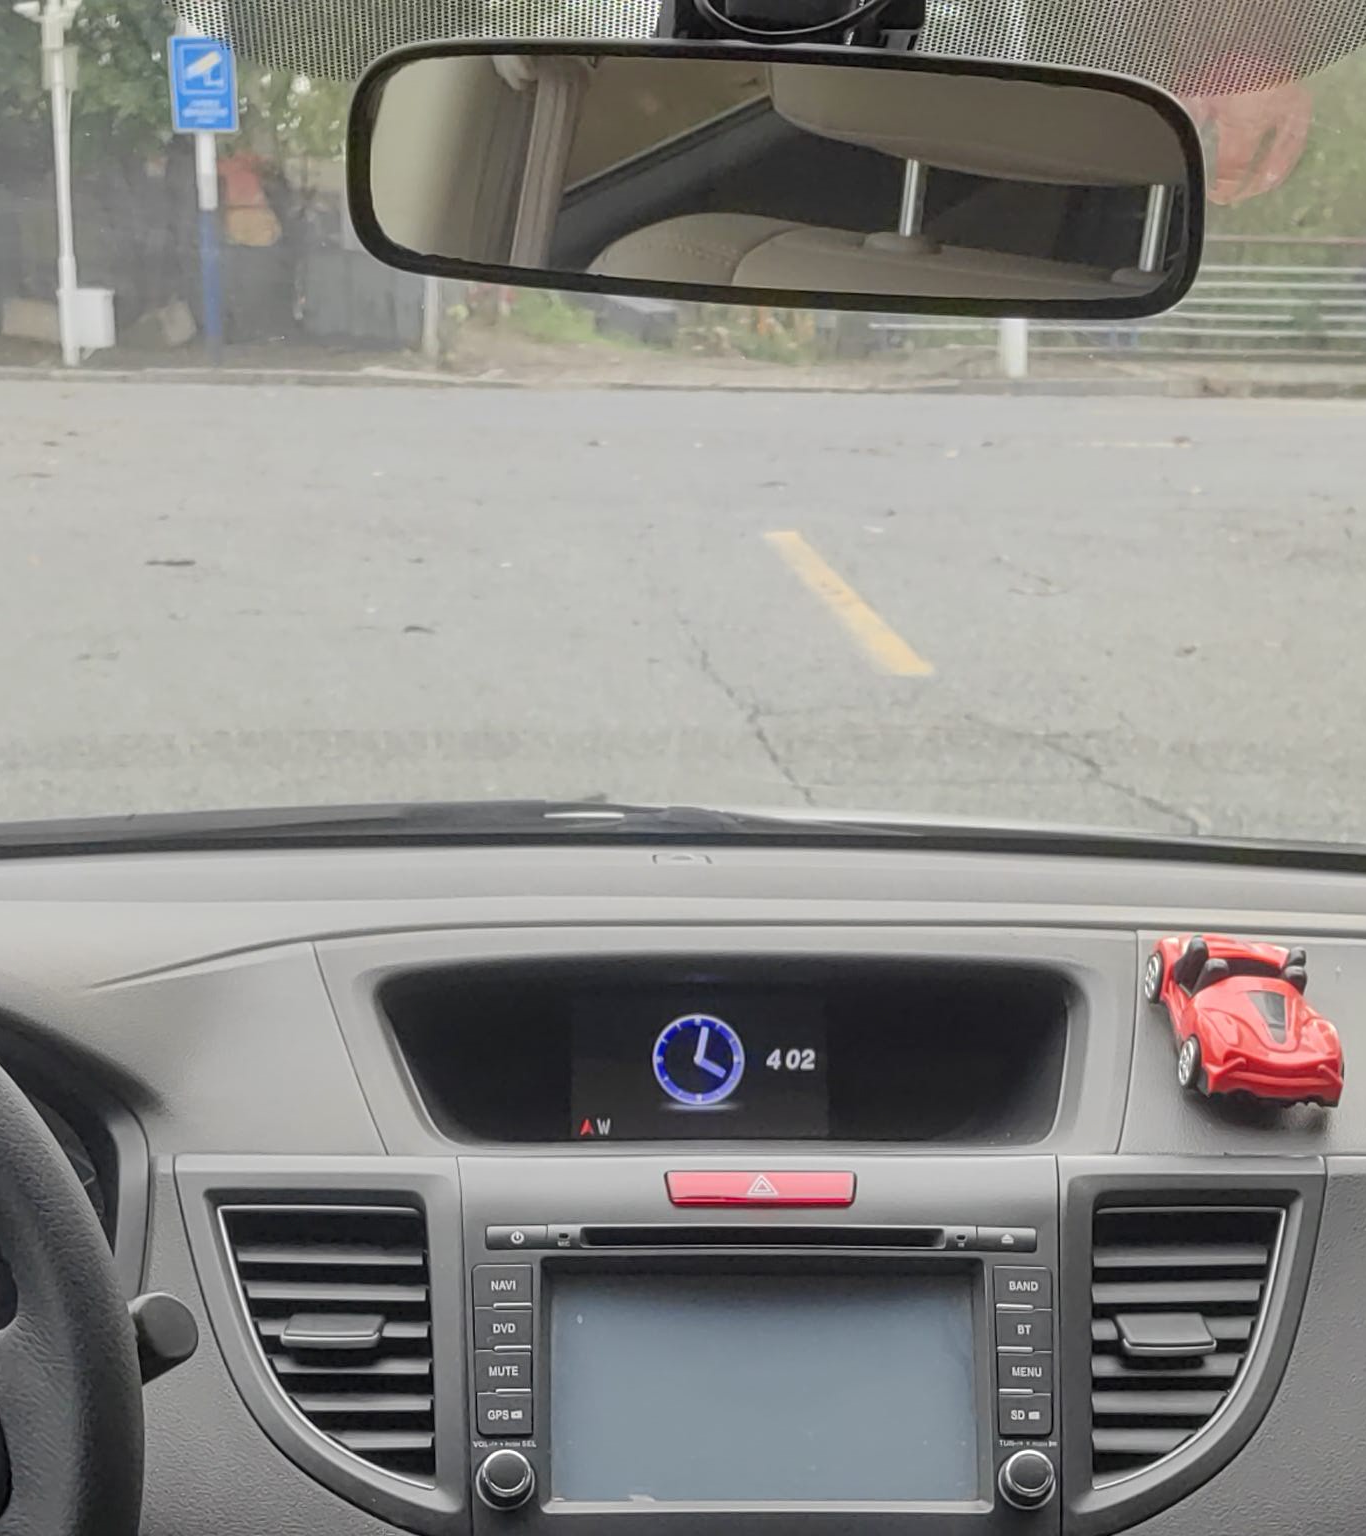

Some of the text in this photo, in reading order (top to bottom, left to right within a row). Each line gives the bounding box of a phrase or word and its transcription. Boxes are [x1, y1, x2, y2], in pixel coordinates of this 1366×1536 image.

[596, 1118, 611, 1135] W
[490, 1280, 517, 1291] NAVI
[1008, 1281, 1039, 1292] BAND
[492, 1323, 516, 1334] DVD
[1017, 1325, 1032, 1335] BT
[488, 1366, 519, 1377] MUTE
[1011, 1367, 1042, 1378] MENU
[487, 1410, 510, 1421] GPS
[1010, 1410, 1026, 1421] SD
